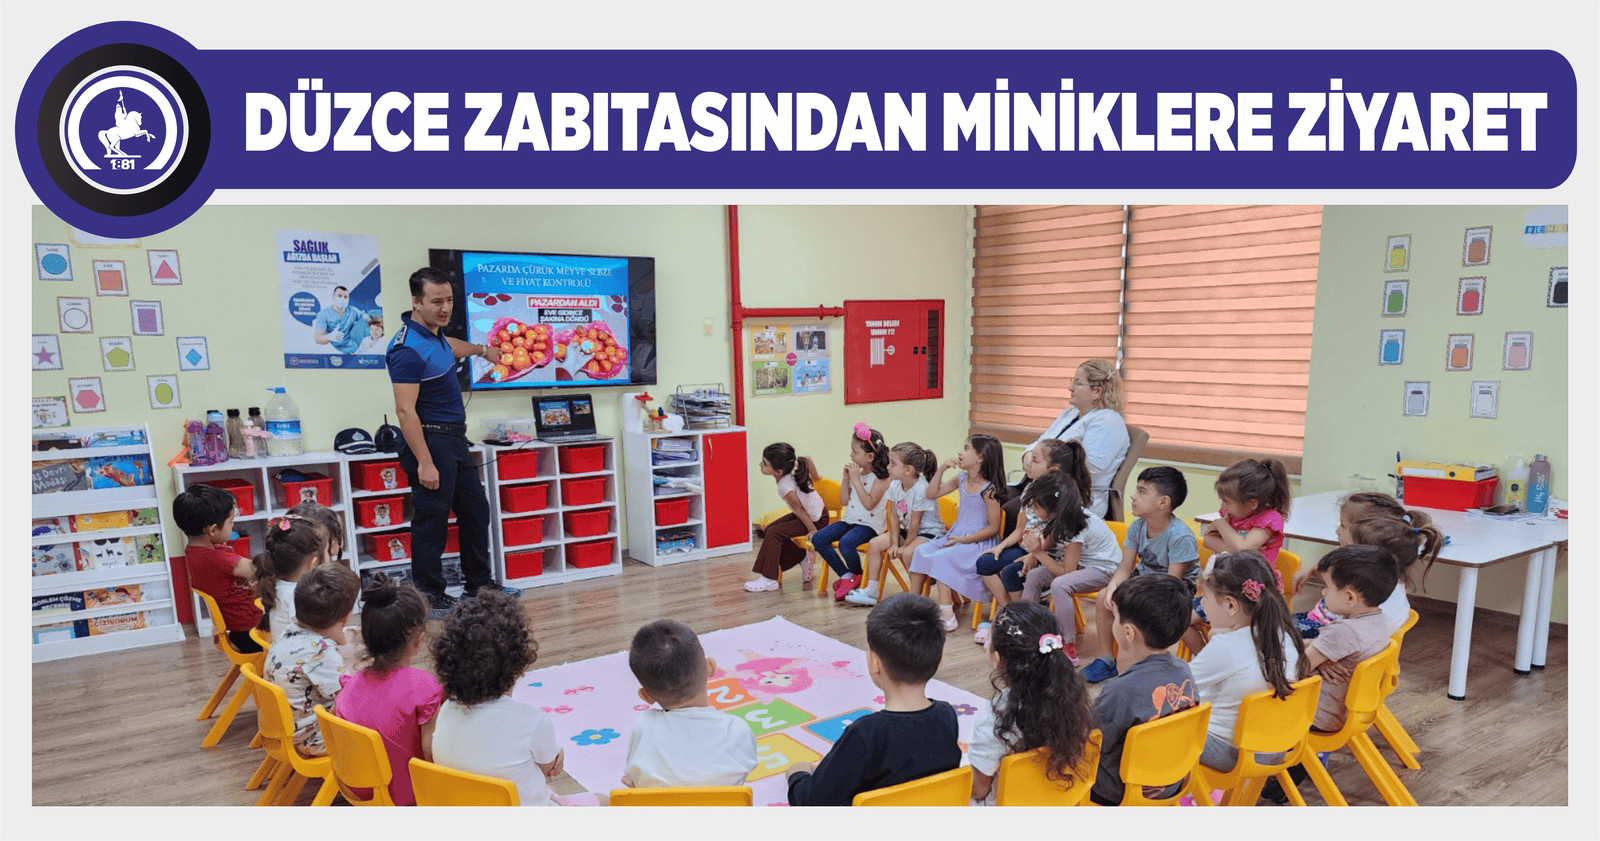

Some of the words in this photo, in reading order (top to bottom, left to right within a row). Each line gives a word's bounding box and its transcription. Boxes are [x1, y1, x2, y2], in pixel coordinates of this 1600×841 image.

[293, 239, 329, 254] SAĞLIK
[477, 264, 520, 274] PAZARDA
[523, 265, 554, 276] ÇÜRÜK
[556, 266, 586, 276] MEYVE
[588, 267, 613, 277] SEBZE
[502, 277, 514, 286] VE
[517, 276, 541, 287] FİYAT
[543, 278, 592, 288] KONTROLÜ
[530, 299, 577, 307] PAZARDAN
[41, 464, 67, 479] Devri
[32, 597, 59, 607] ROBLEM
